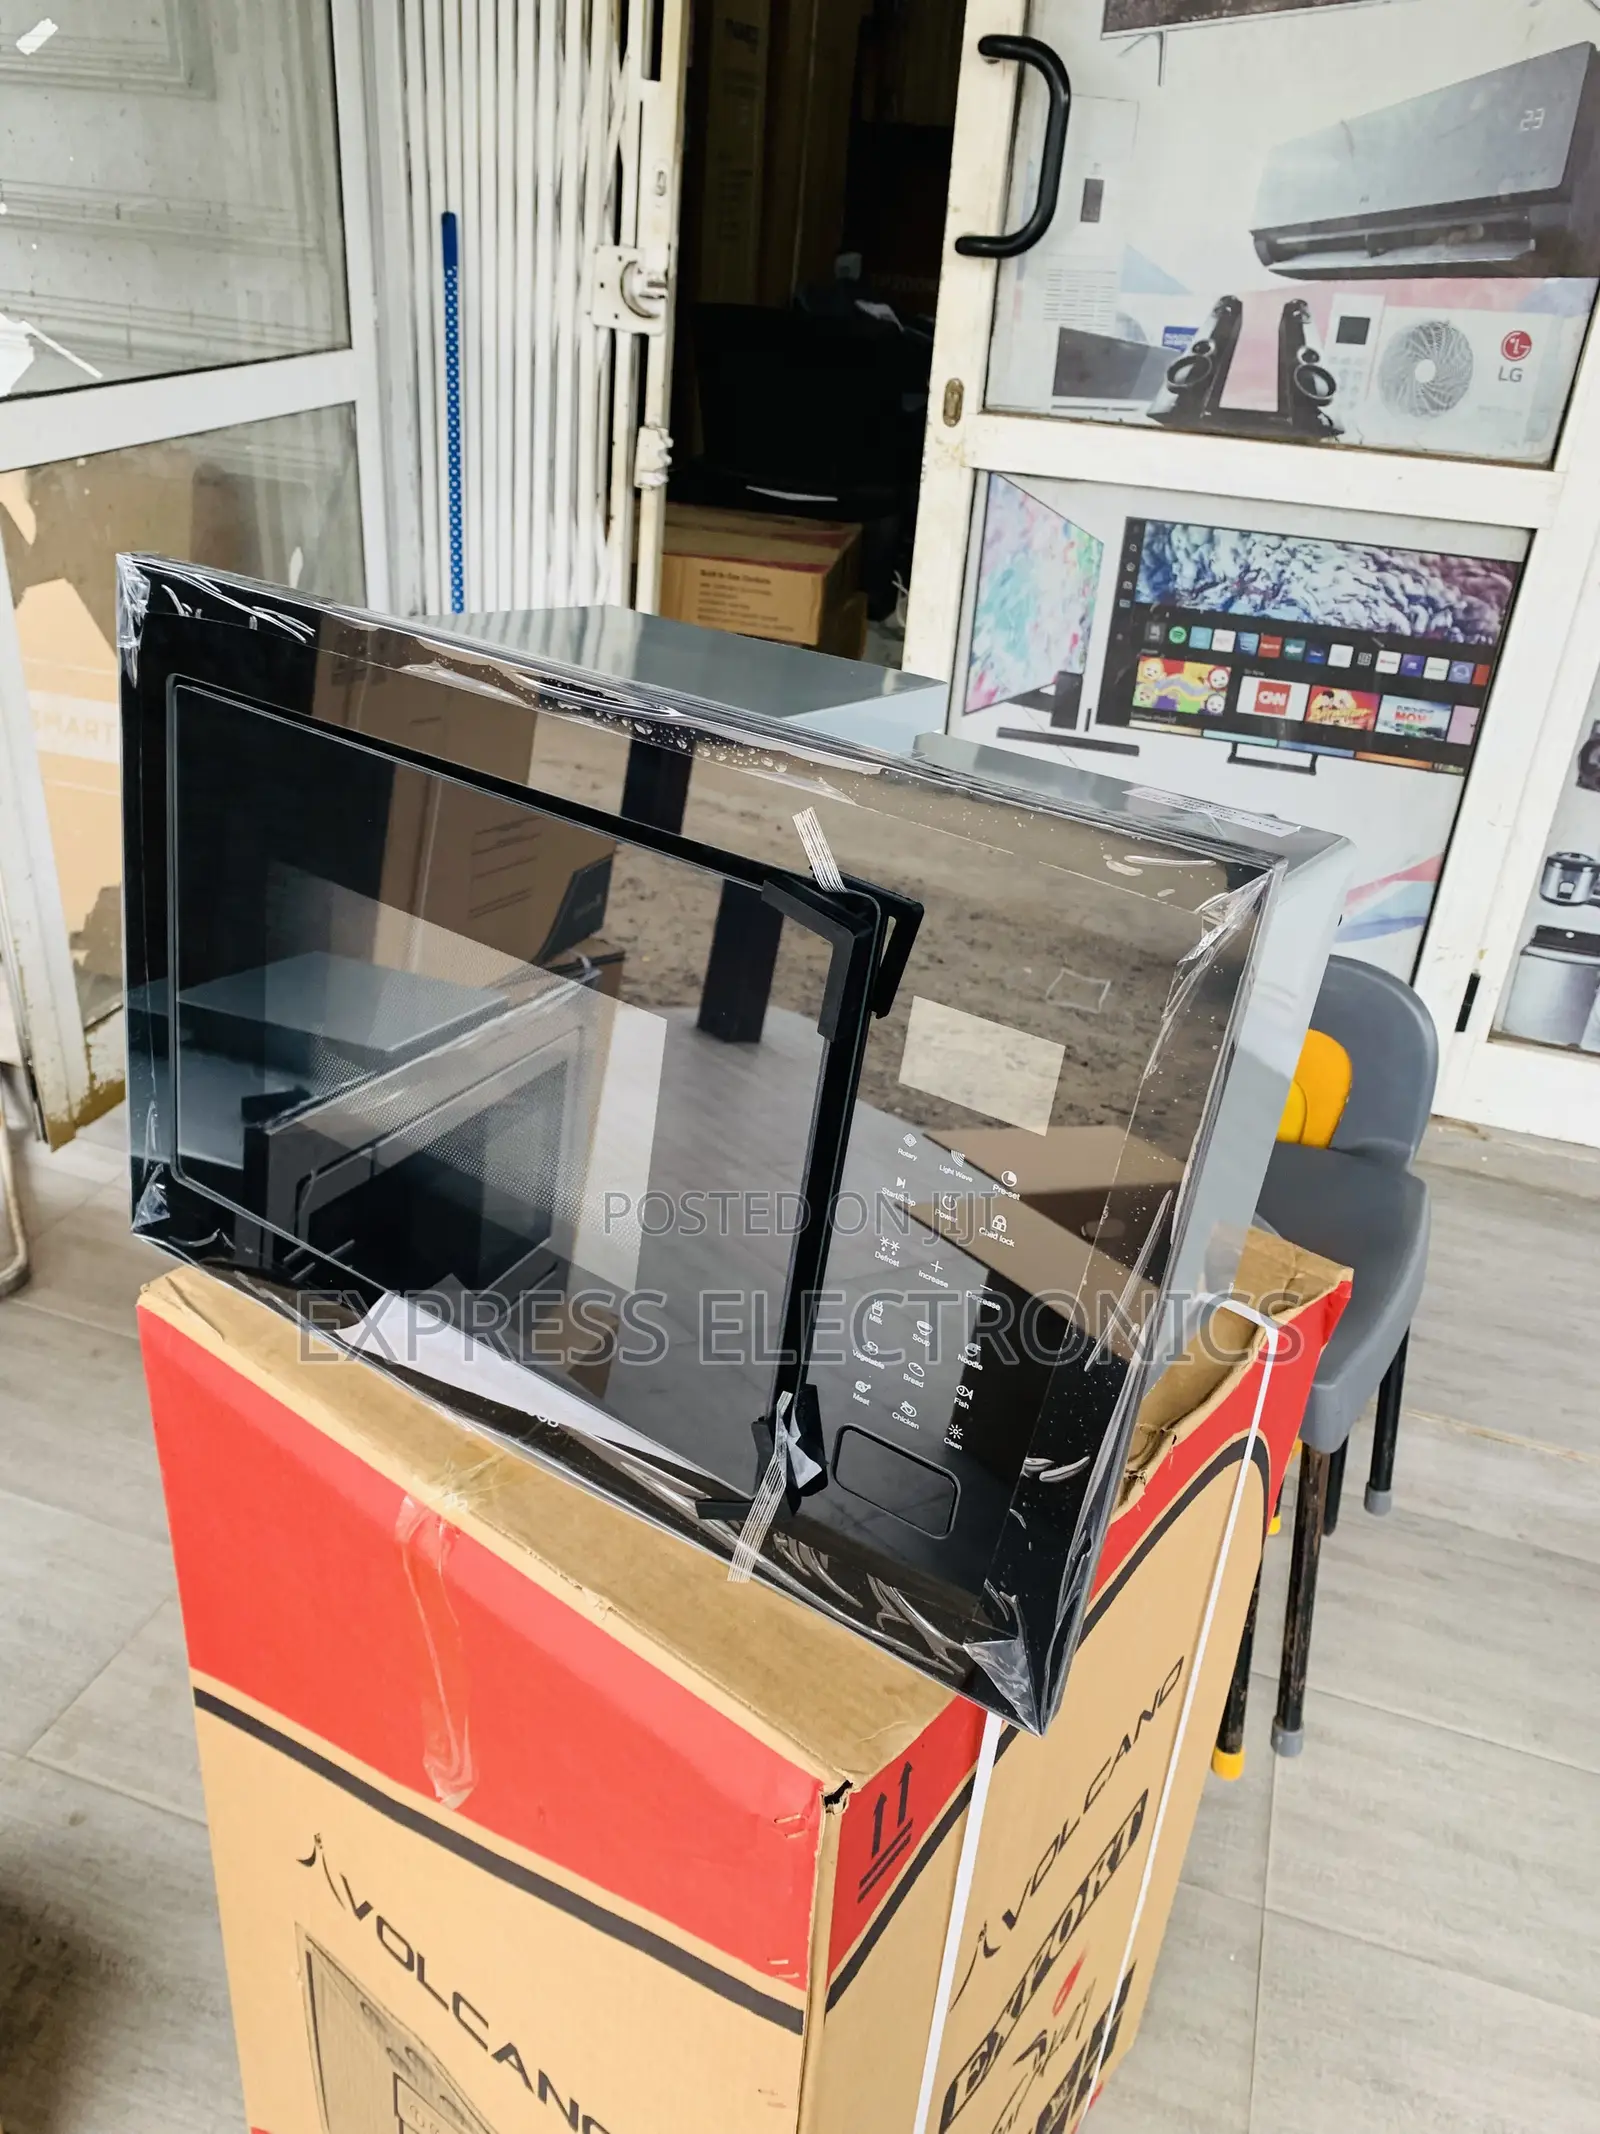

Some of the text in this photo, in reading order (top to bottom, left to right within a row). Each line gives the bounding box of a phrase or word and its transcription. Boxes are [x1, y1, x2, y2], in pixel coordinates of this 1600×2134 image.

[1498, 366, 1523, 382] LG
[898, 1148, 917, 1161] Rotary
[939, 1164, 973, 1183] Light Wave
[881, 1187, 916, 1207] Start/Stop
[992, 1183, 1021, 1201] Pre-set
[934, 1208, 958, 1223] Power
[979, 1227, 1016, 1247] Child lock
[874, 1251, 900, 1267] Defrost
[918, 1270, 949, 1288] Increase
[966, 1290, 1001, 1311] Decrease
[868, 1314, 884, 1326] Milk
[912, 1333, 931, 1347] Soup
[957, 1353, 983, 1371] Noodle
[903, 1373, 924, 1388] Bread
[853, 1392, 870, 1406] Meat
[954, 1397, 970, 1410] Fish
[892, 1411, 920, 1430] Chicken
[943, 1437, 963, 1450] Clean
[1002, 1656, 1184, 1930] VOLCANO
[949, 1795, 1142, 2122] EXPORT
